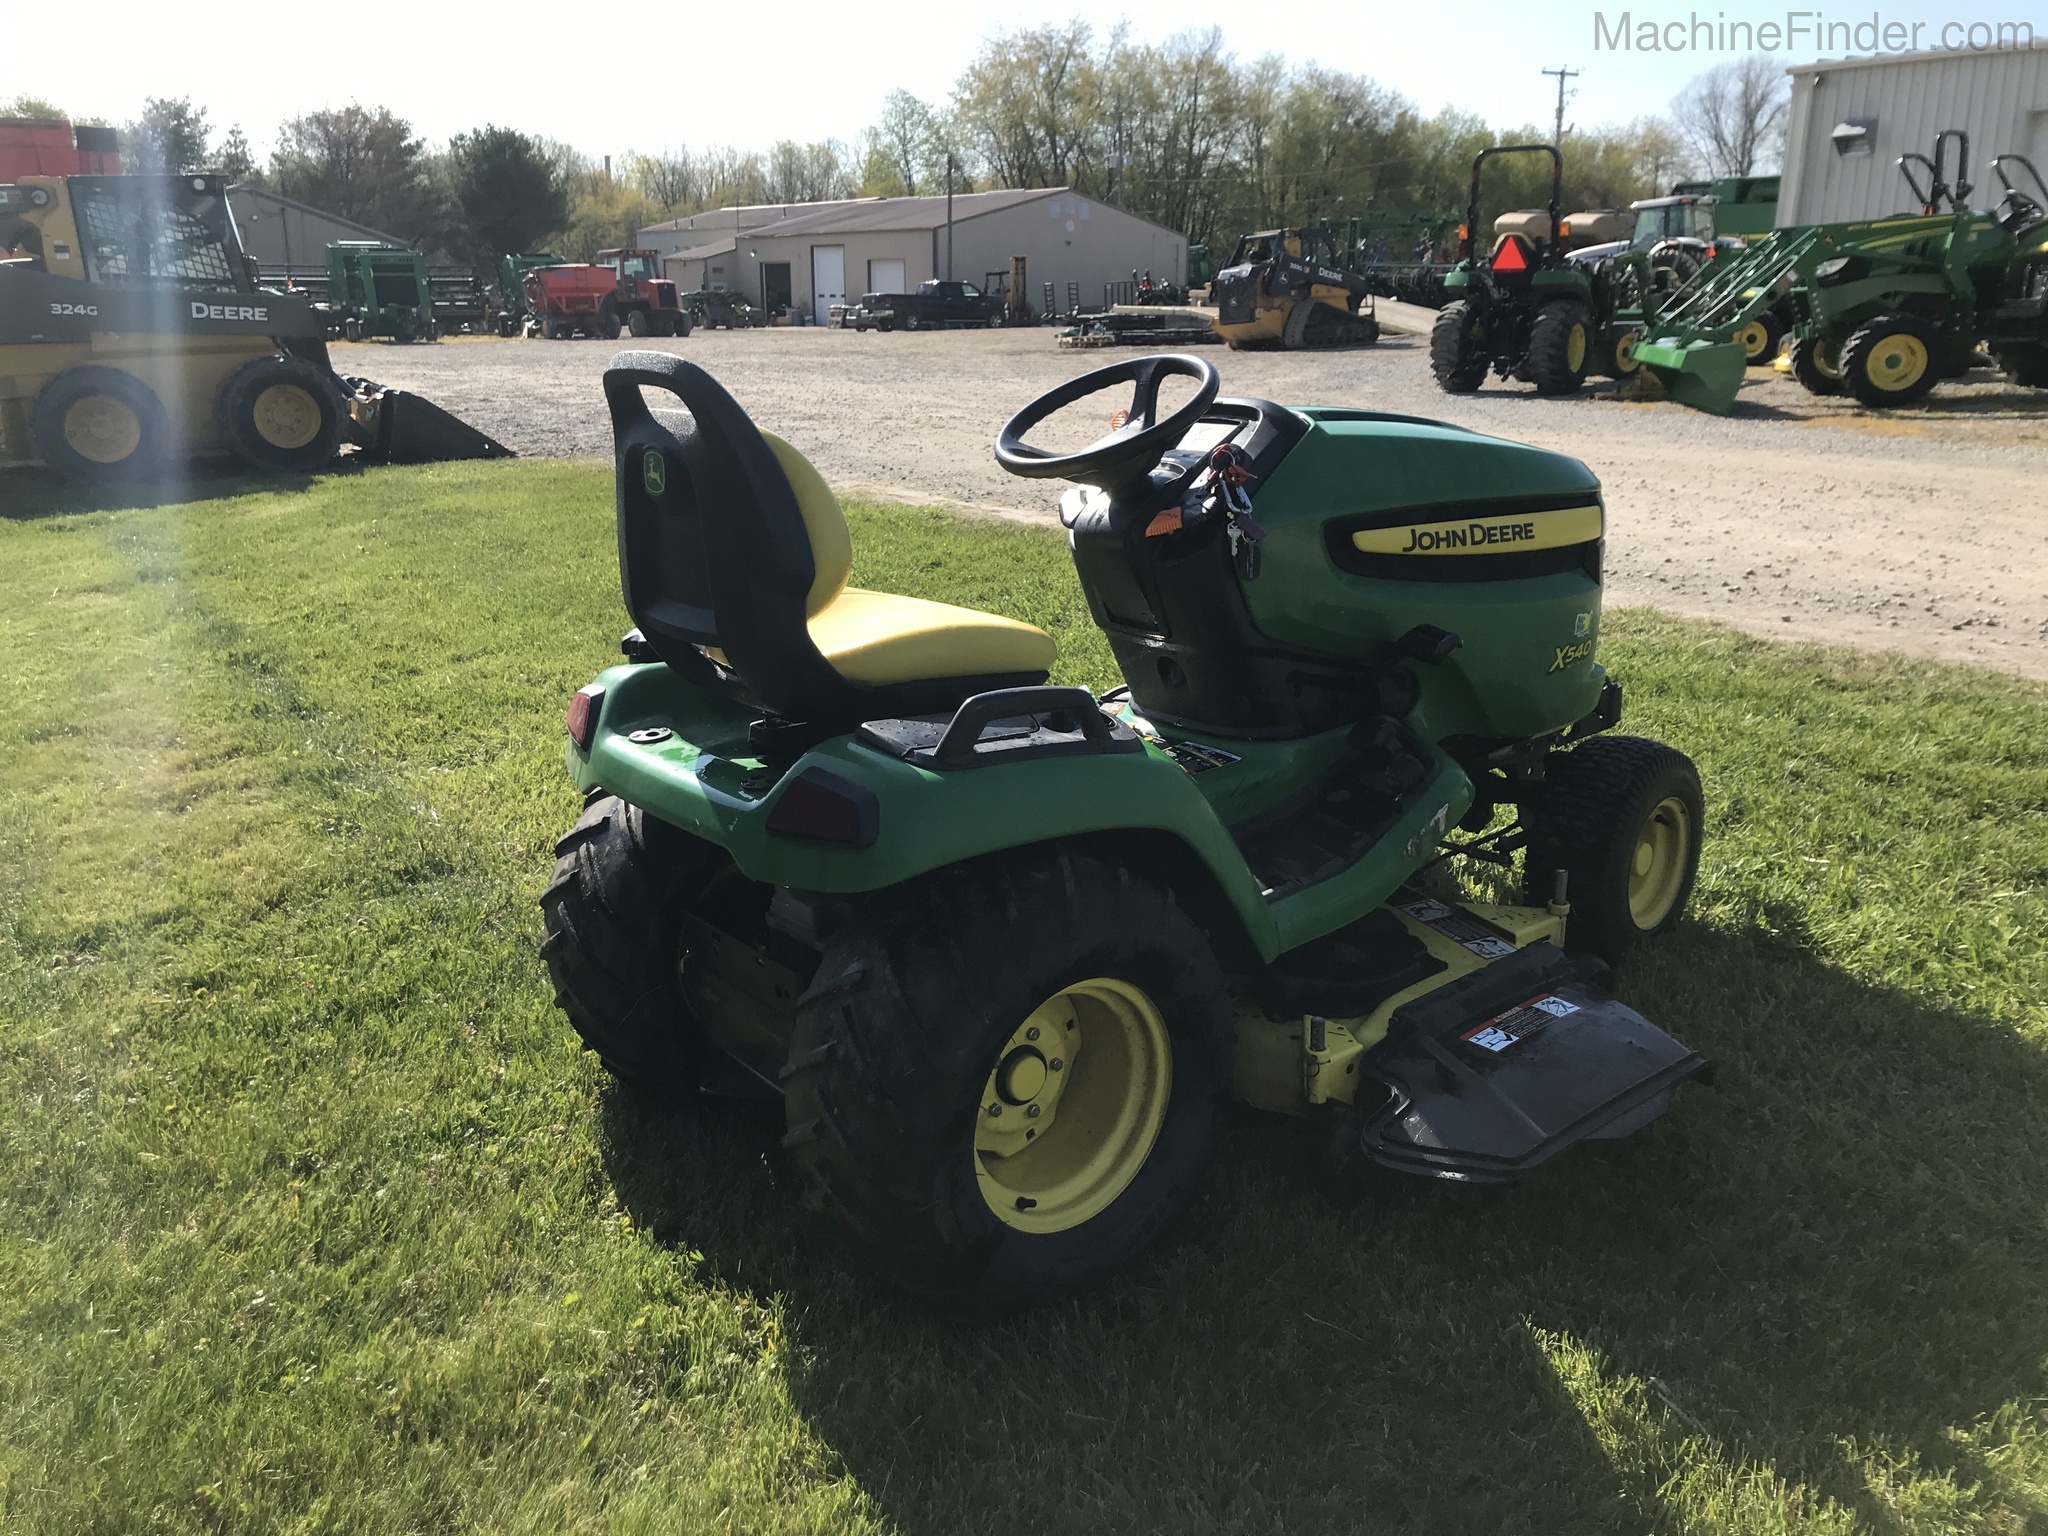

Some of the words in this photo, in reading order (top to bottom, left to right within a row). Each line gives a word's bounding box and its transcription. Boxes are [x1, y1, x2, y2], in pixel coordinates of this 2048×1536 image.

[1318, 266, 1343, 282] DEERE
[50, 303, 98, 316] 324G
[190, 301, 268, 321] DEERE
[1402, 529, 1467, 552] JOHN
[1468, 523, 1535, 546] DEERE
[1547, 640, 1592, 673] X540
